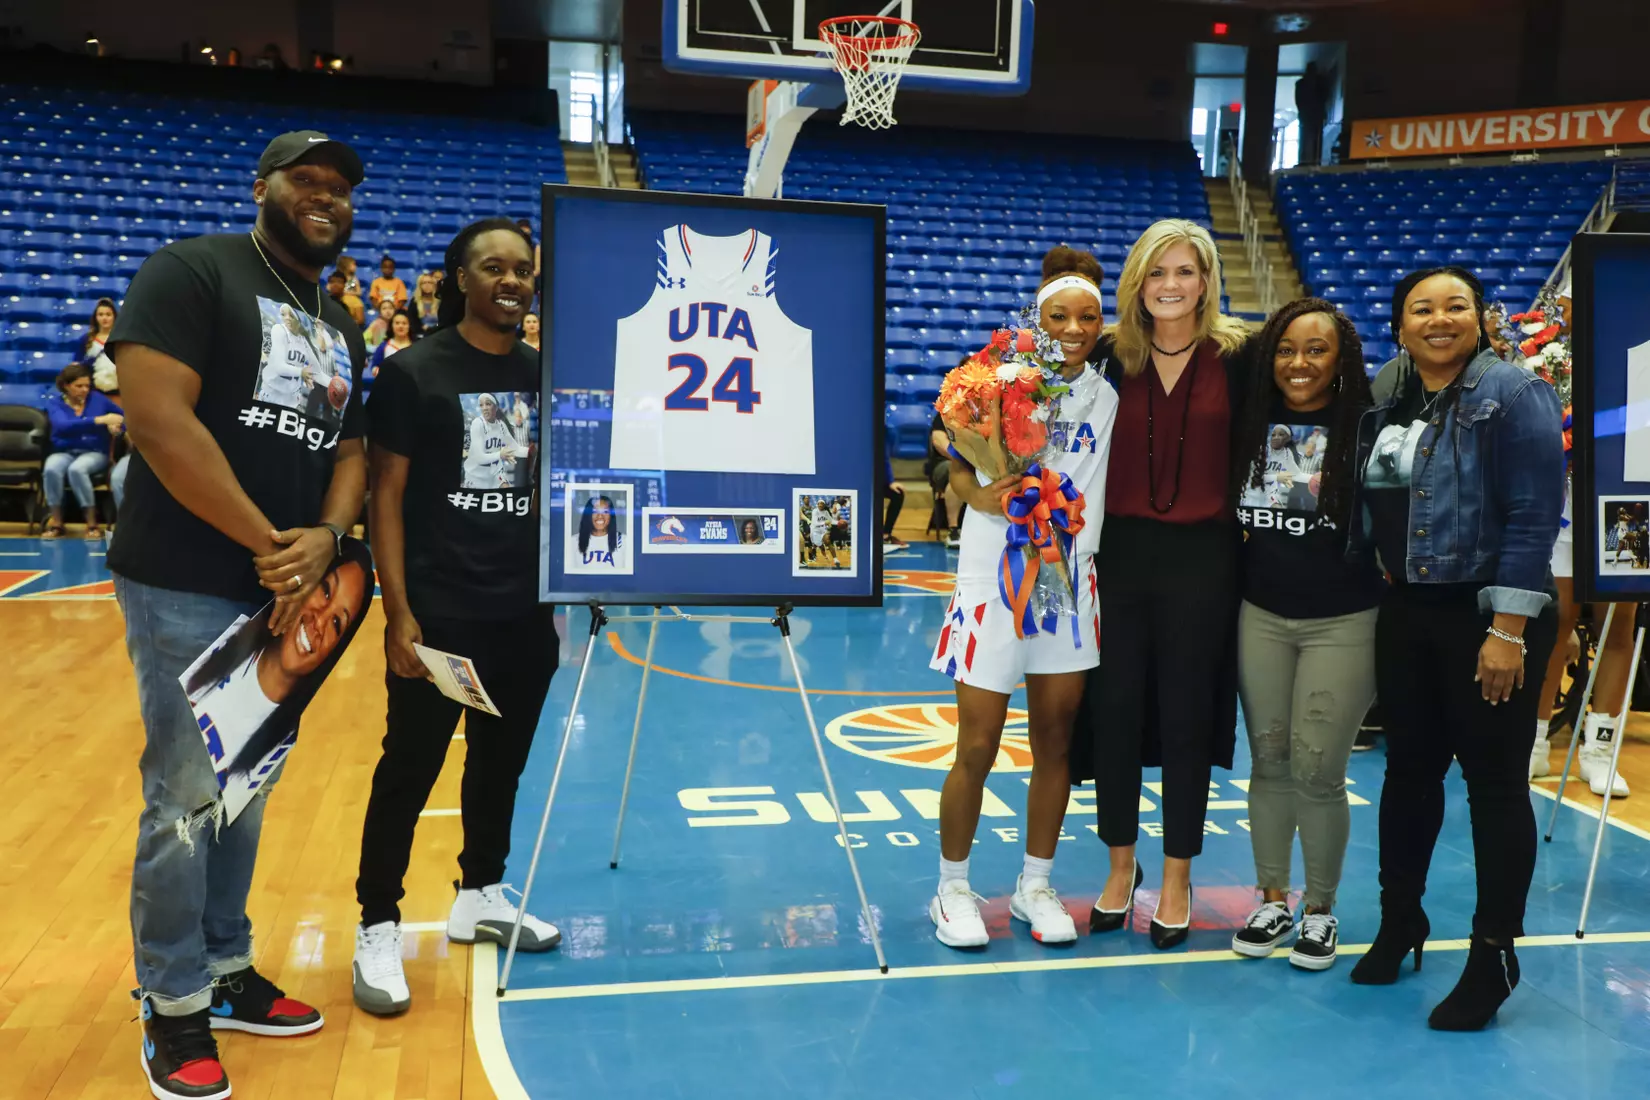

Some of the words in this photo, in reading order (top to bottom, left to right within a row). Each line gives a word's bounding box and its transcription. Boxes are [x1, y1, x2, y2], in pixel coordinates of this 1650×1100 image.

[1389, 108, 1625, 150] UNIVERSITY
[669, 302, 759, 352] UTA
[287, 349, 309, 364] UTA
[664, 352, 761, 414] 24
[485, 436, 506, 450] UTA
[763, 516, 777, 531] 24
[699, 527, 728, 540] EVANS
[583, 549, 615, 568] UTA
